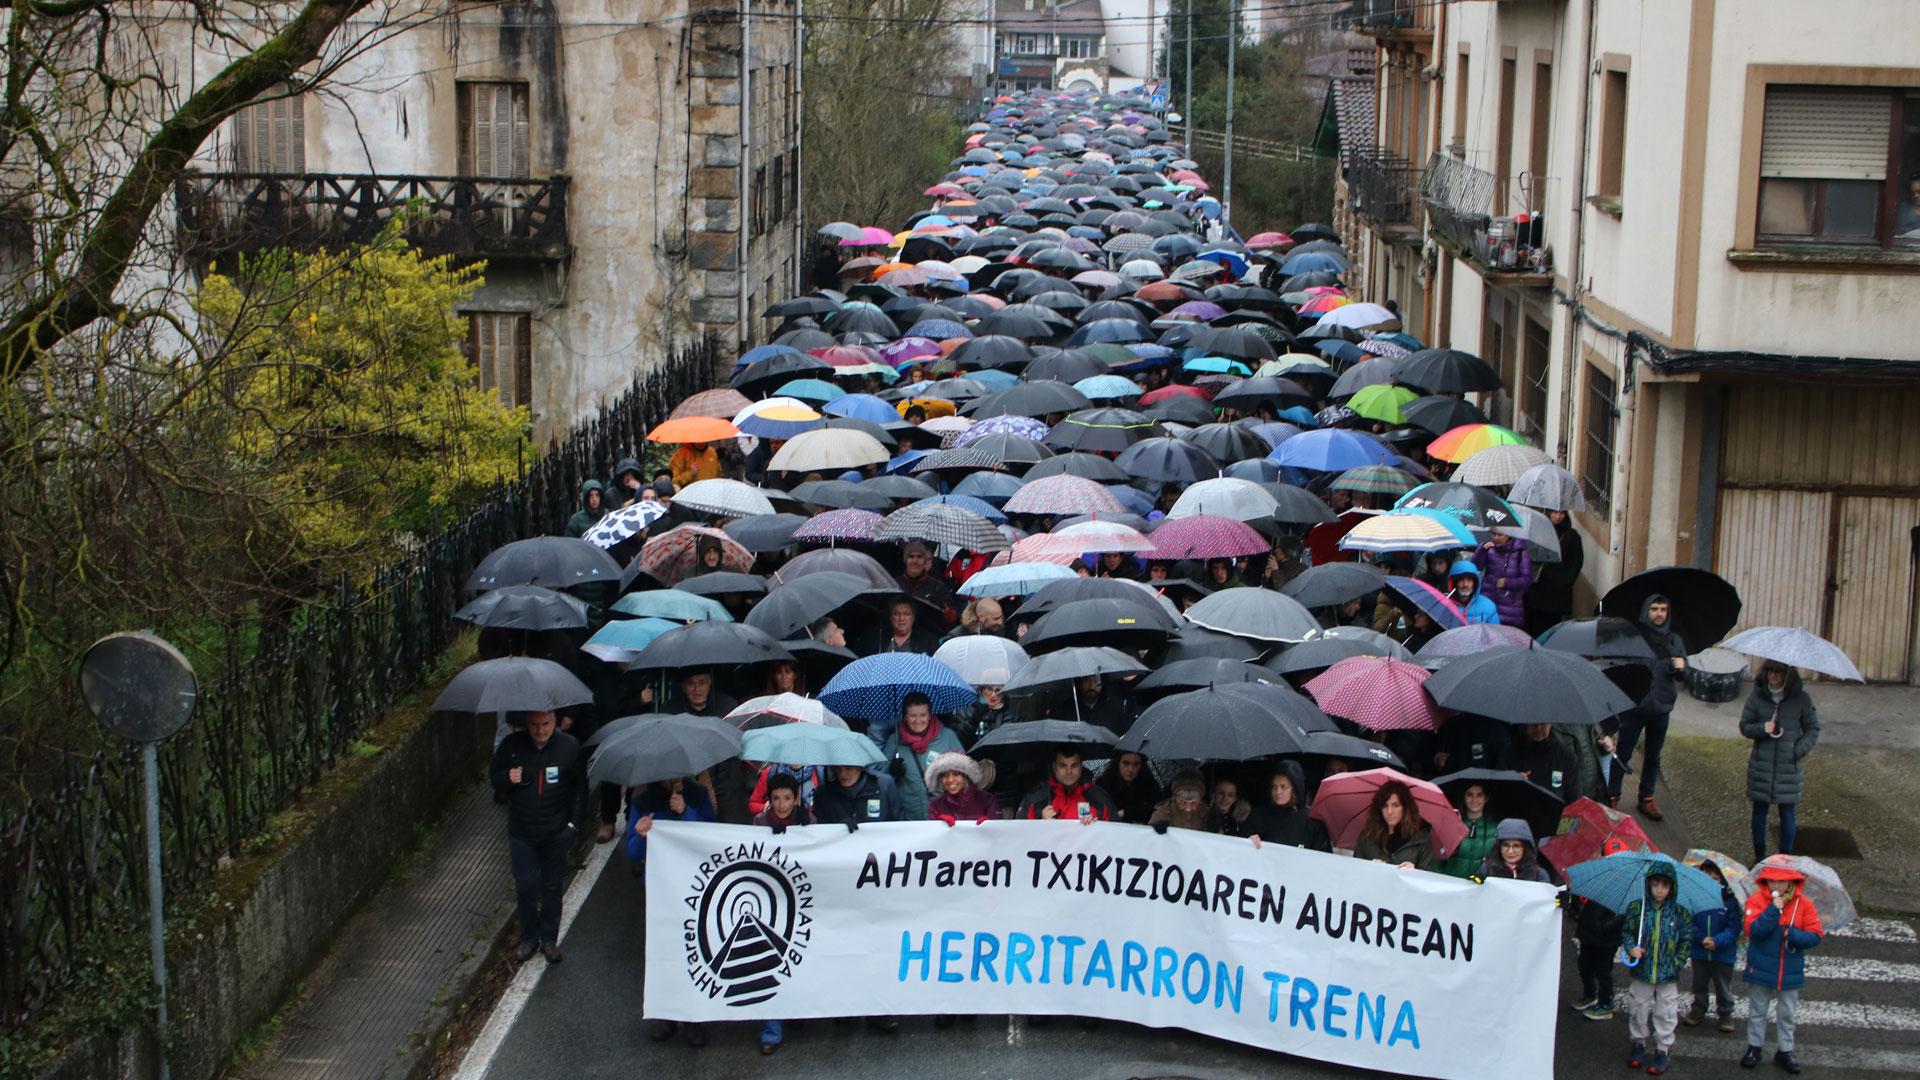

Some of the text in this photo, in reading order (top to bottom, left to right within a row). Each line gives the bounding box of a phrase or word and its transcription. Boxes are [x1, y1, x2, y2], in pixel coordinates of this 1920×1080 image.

[683, 841, 814, 1000] AHTaren AURREAN ALTERNATIBA
[856, 850, 1474, 962] AHTaren TXIKIZIOAREN AURREAN
[897, 930, 1422, 1052] HERRITARRON TRENA
